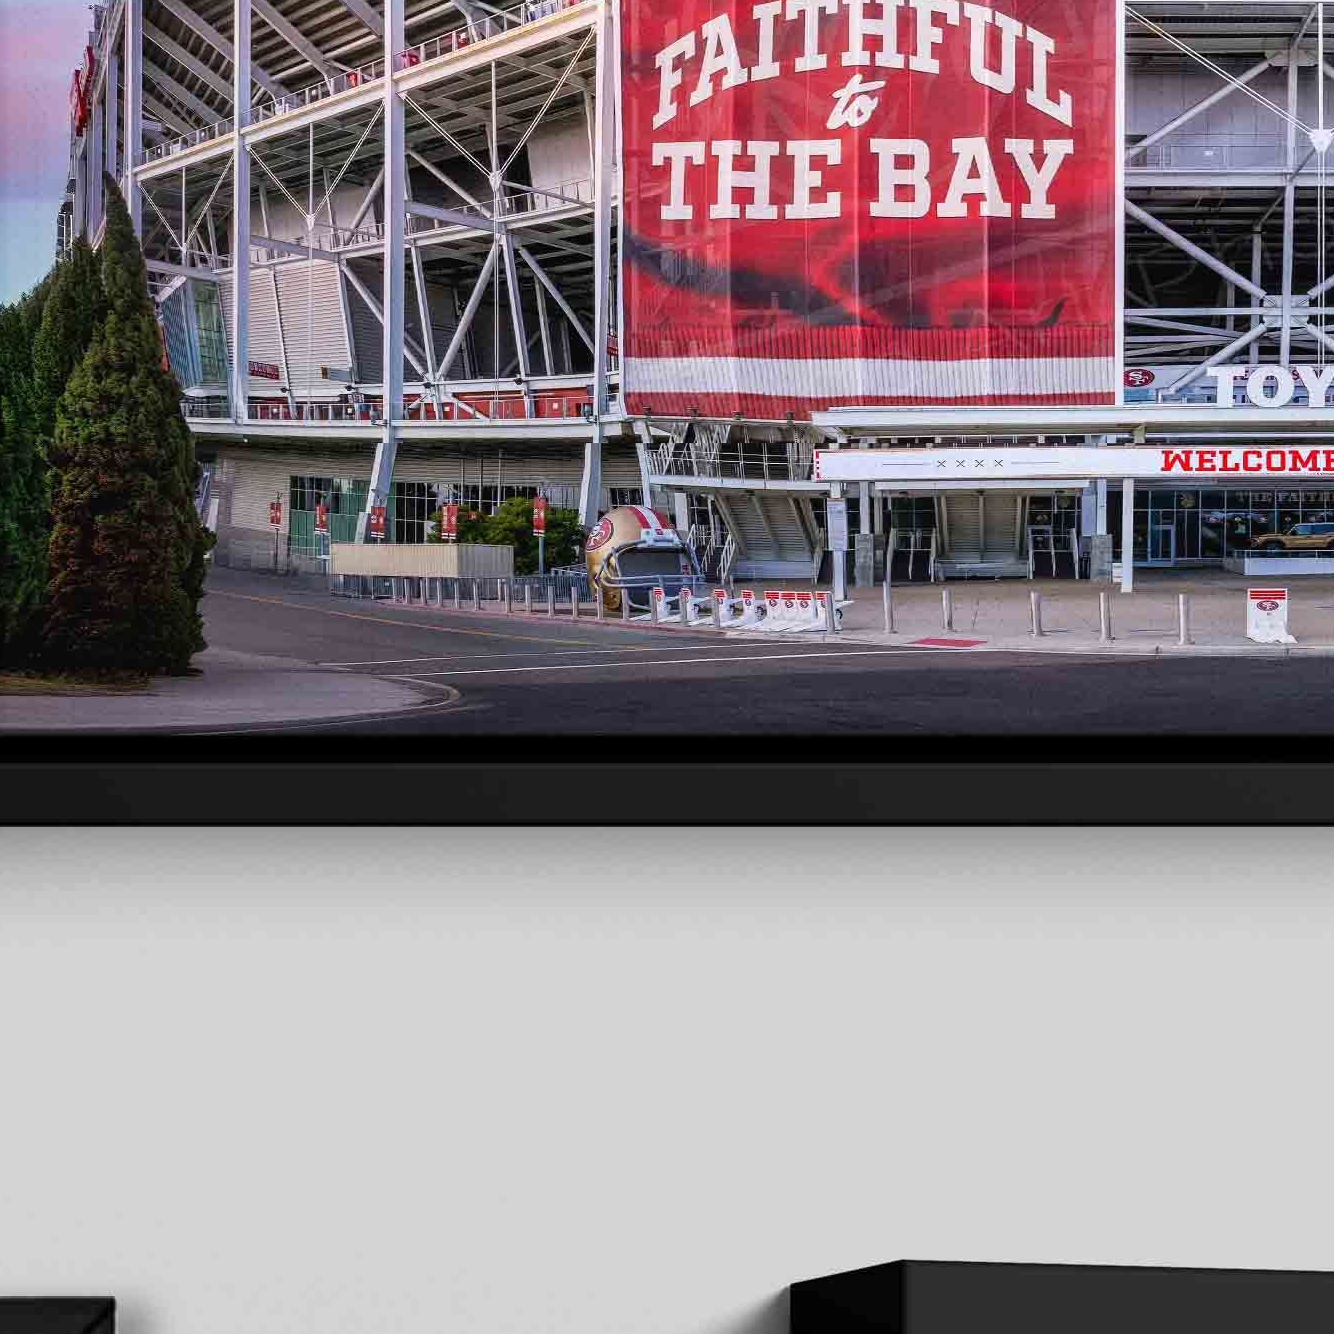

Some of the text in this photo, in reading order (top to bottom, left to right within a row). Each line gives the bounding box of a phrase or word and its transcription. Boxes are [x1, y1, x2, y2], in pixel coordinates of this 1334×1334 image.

[826, 74, 885, 131] to
[652, 136, 1074, 221] THE BAY
